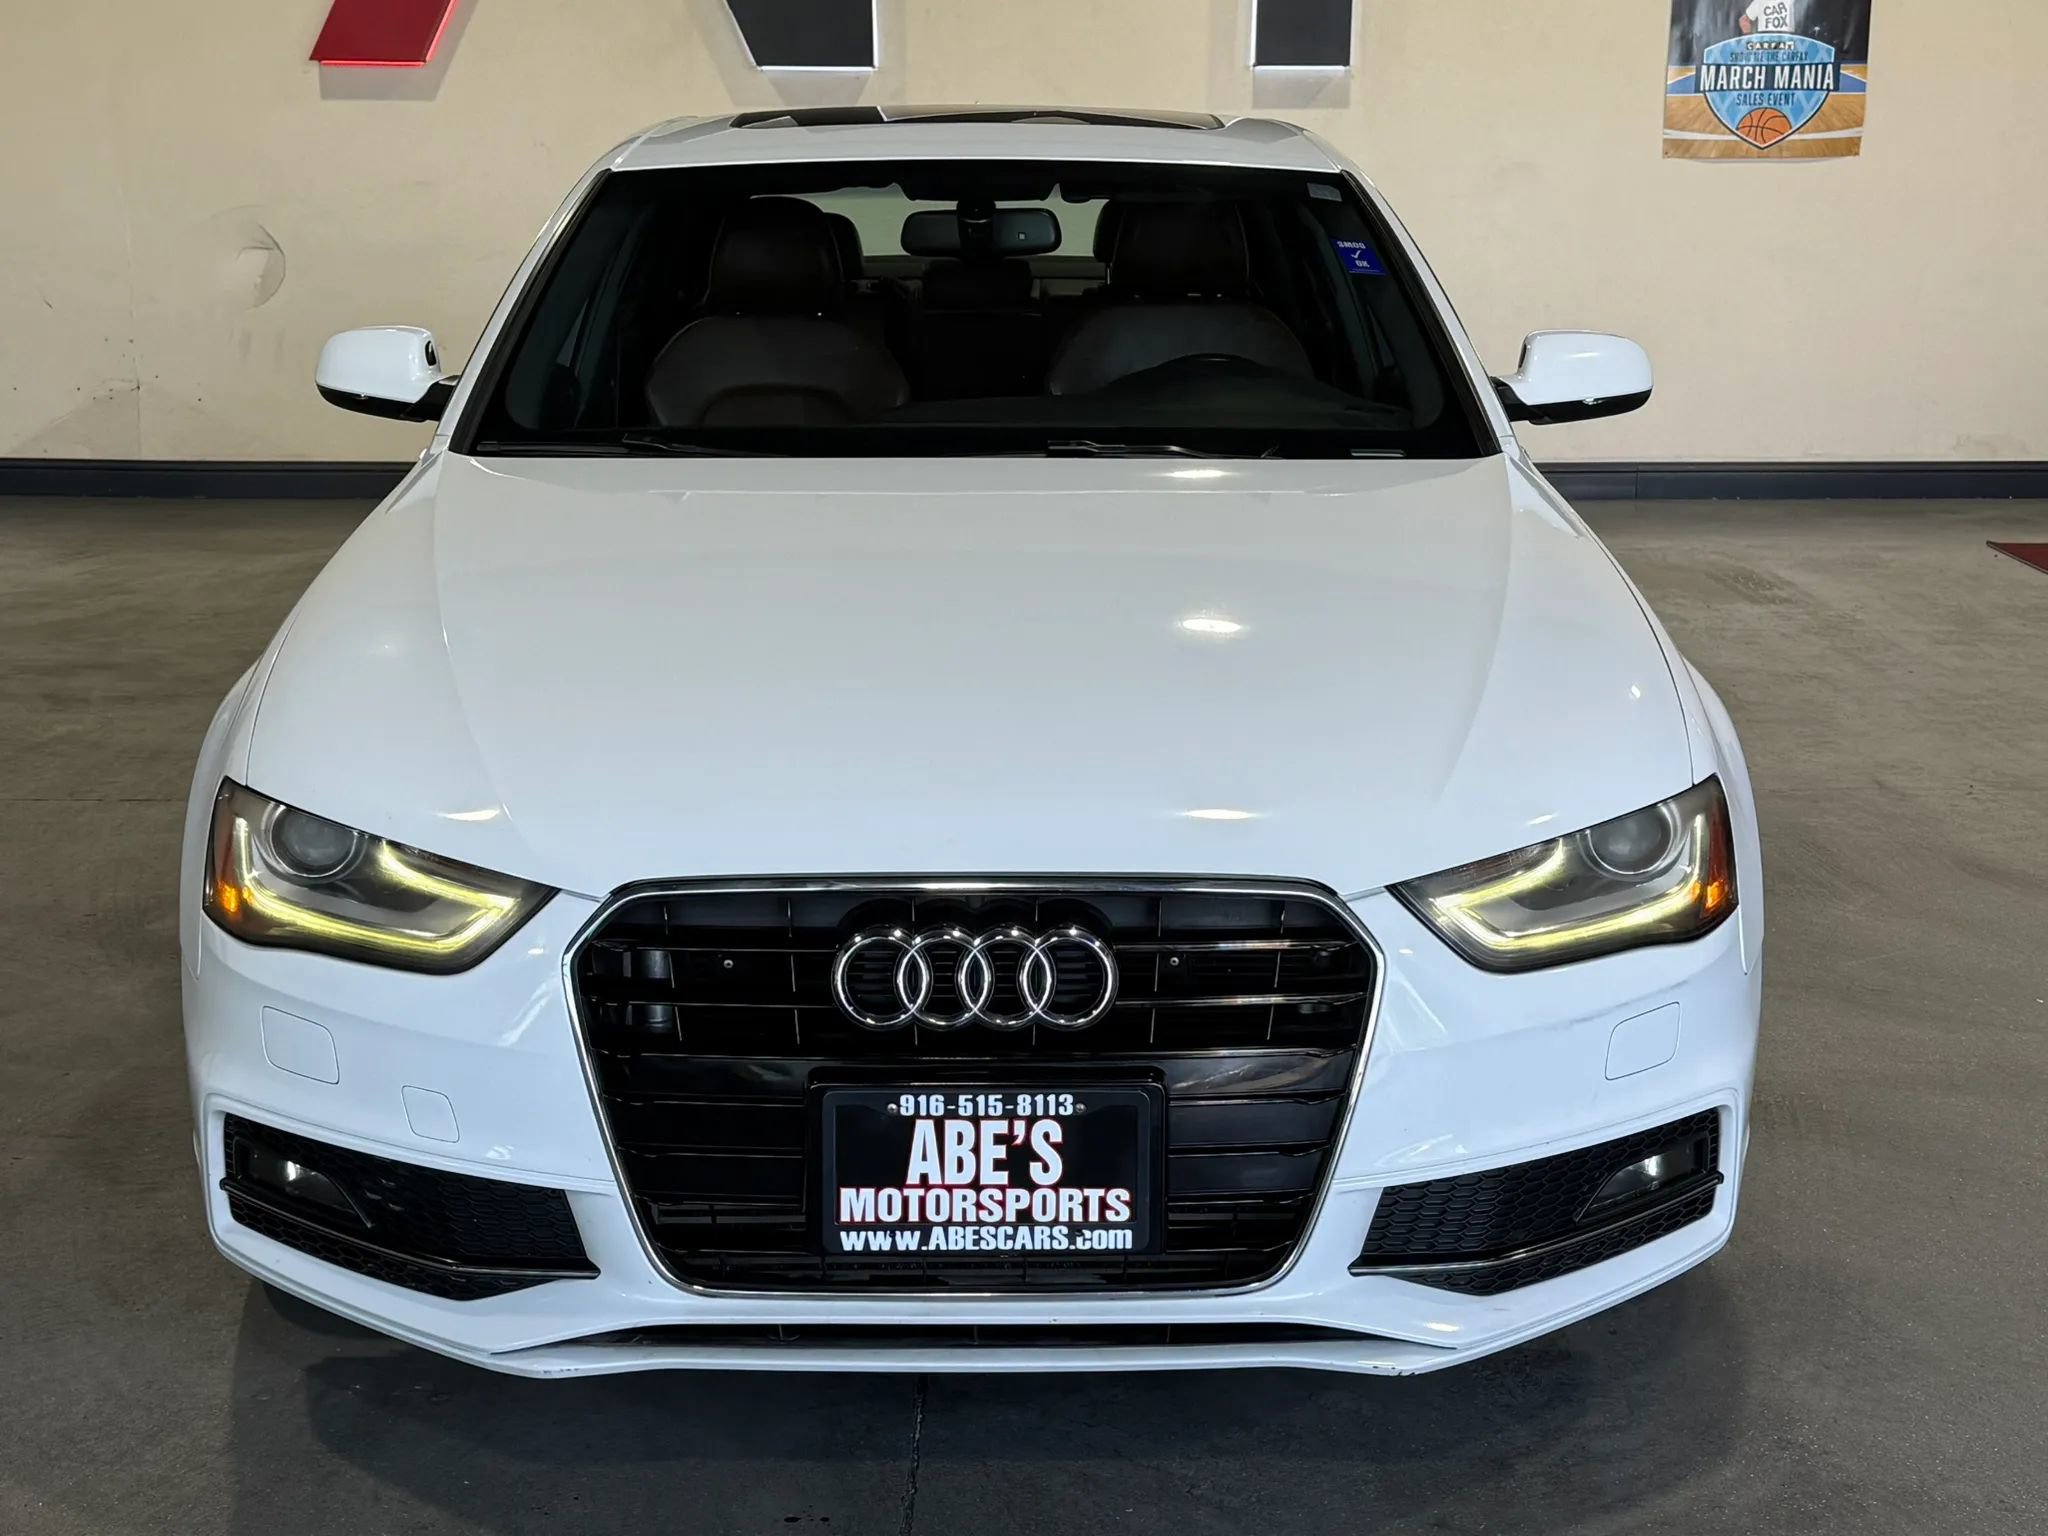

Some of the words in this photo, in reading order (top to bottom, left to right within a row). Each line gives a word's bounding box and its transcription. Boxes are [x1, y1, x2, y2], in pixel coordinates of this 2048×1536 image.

[1763, 2, 1787, 17] CAR
[1764, 15, 1788, 29] FOX
[1782, 51, 1808, 62] CARFAX
[1700, 64, 1765, 91] MARCH
[1774, 63, 1834, 90] MANIA
[1736, 93, 1764, 106] SALES
[1767, 92, 1796, 106] EVENT
[899, 1094, 1074, 1117] 916-515-8113
[905, 1118, 1064, 1186] ABE'S
[839, 1187, 1131, 1223] MOTORSPORTS
[840, 1226, 1133, 1251] www.ABESCARS.com
